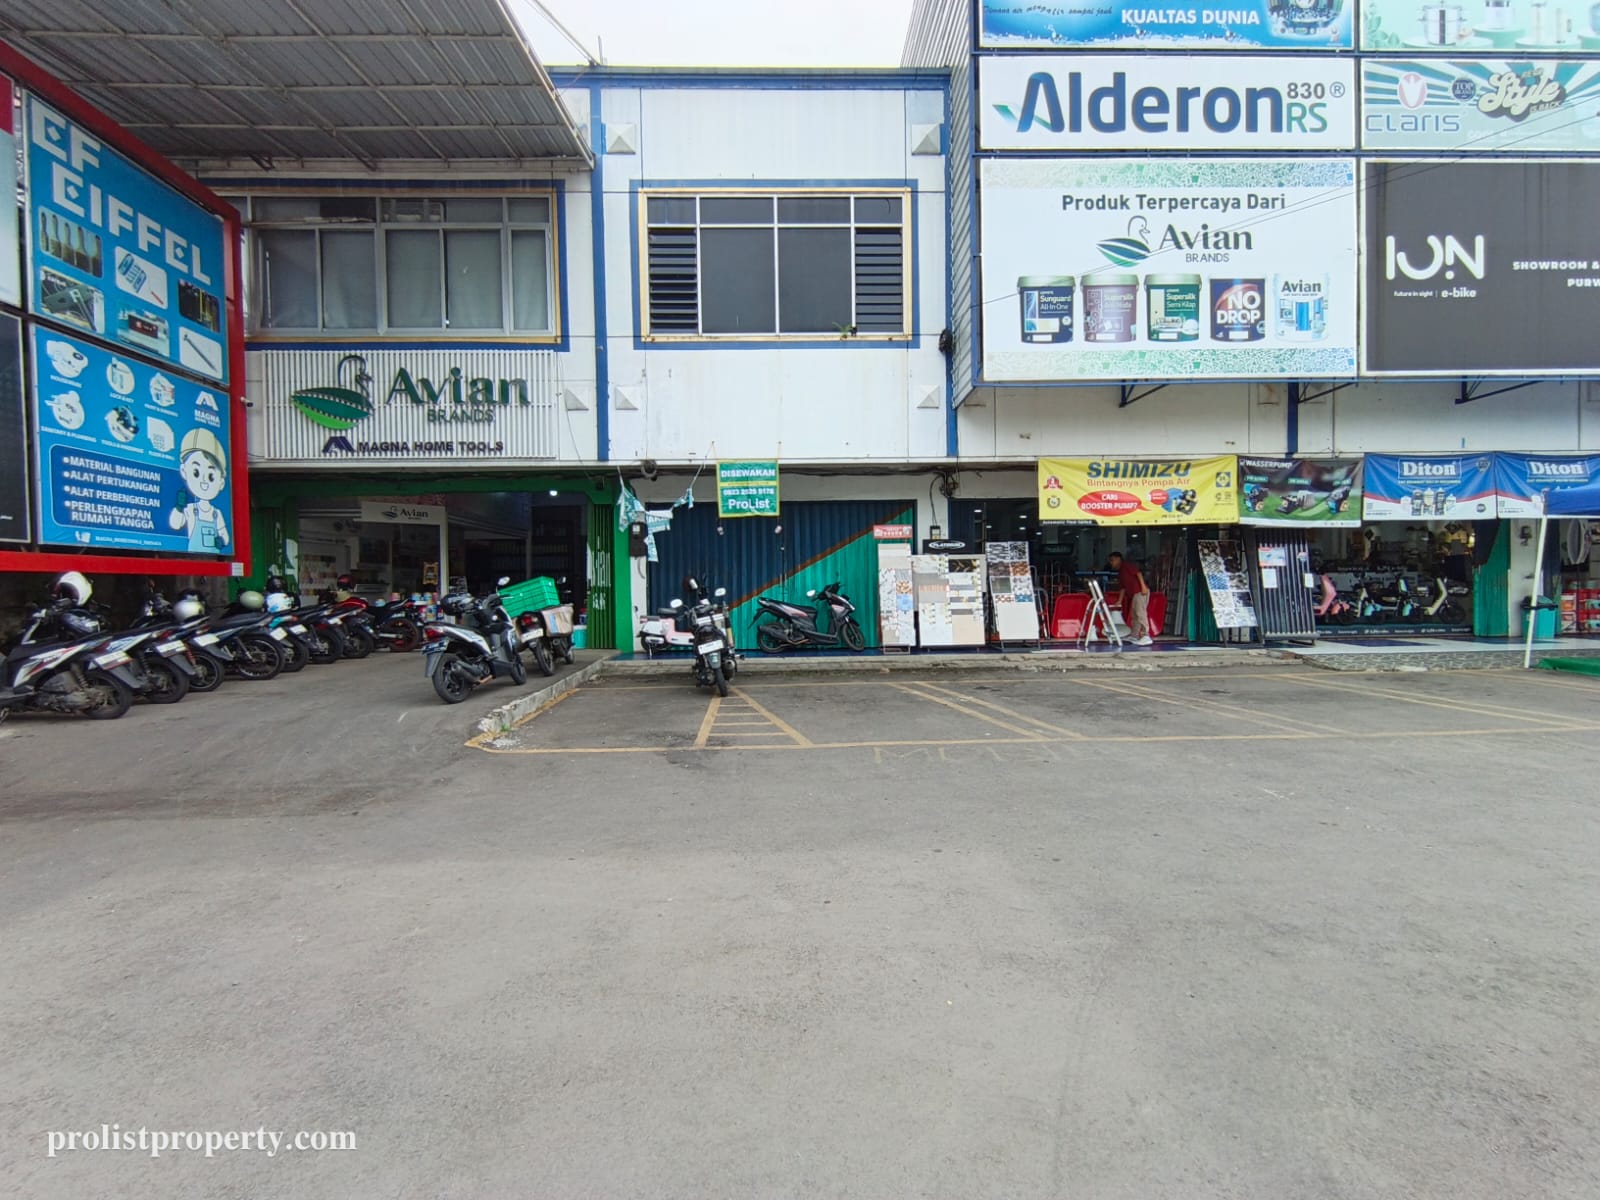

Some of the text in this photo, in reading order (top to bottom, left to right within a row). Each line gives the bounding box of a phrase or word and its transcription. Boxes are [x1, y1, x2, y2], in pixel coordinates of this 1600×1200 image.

[1122, 10, 1259, 24] KUALTAS DUNIA
[1287, 83, 1325, 99] 830
[1478, 72, 1560, 115] Style
[1017, 72, 1283, 133] Alderon
[1287, 103, 1327, 132] RS
[31, 98, 102, 172] EF
[1063, 193, 1286, 213] Produk Terpercaya Dari
[53, 162, 211, 285] EIFFEL
[1159, 224, 1254, 250] Avian
[1186, 253, 1230, 263] BRANDS
[1512, 261, 1600, 270] SHOWROOM &
[1281, 280, 1322, 292] Avian
[1441, 287, 1477, 298] e-bike
[1040, 295, 1071, 303] Sunguard
[1167, 293, 1195, 301] Supersilk
[1228, 290, 1261, 309] NO
[1217, 310, 1261, 324] DROP
[386, 367, 531, 404] Avian
[194, 409, 220, 423] MAGNA
[427, 409, 495, 423] BRANDS
[359, 441, 504, 452] MAGNA HOME TOOLS
[70, 456, 161, 482] MATERIAL BANGUNAN
[721, 469, 776, 478] DISEWAKAN
[1087, 462, 1191, 478] SHIMIZU
[1402, 461, 1456, 476] Diton
[1529, 461, 1584, 475] Diton
[70, 471, 160, 493] ALAT PERTUKANGAN
[1087, 478, 1139, 488] Bintangnya
[1142, 479, 1175, 487] Pompa
[70, 486, 161, 507] ALAT PERBENGKELAN
[728, 498, 770, 509] ProList
[71, 500, 151, 519] PERLENGKAPAN
[400, 508, 429, 518] Avian
[1081, 502, 1111, 510] BOOSTER
[72, 511, 154, 529] RUMAH TANGGA
